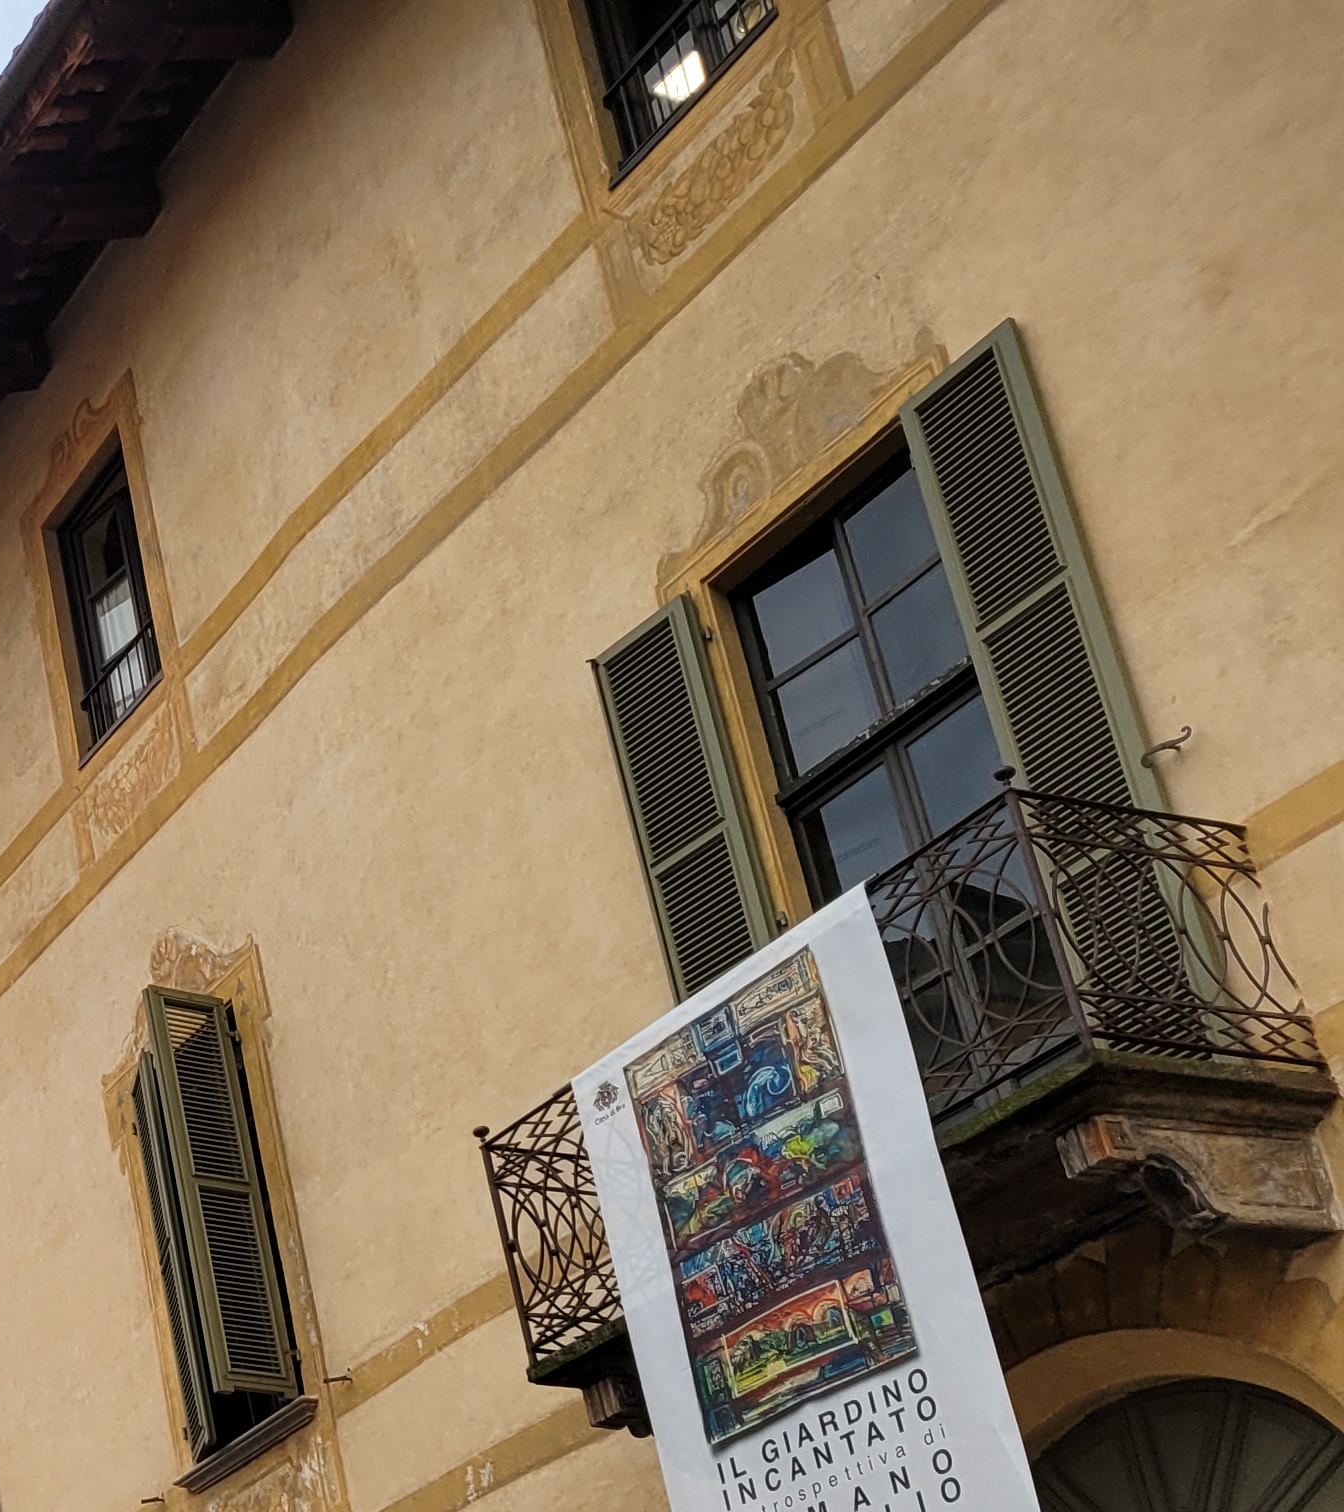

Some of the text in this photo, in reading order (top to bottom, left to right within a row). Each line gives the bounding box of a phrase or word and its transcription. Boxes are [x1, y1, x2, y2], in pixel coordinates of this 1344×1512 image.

[717, 1368, 928, 1484] IL GIARDINO
[722, 1395, 937, 1511] INCANTATO
[923, 1423, 946, 1446] di
